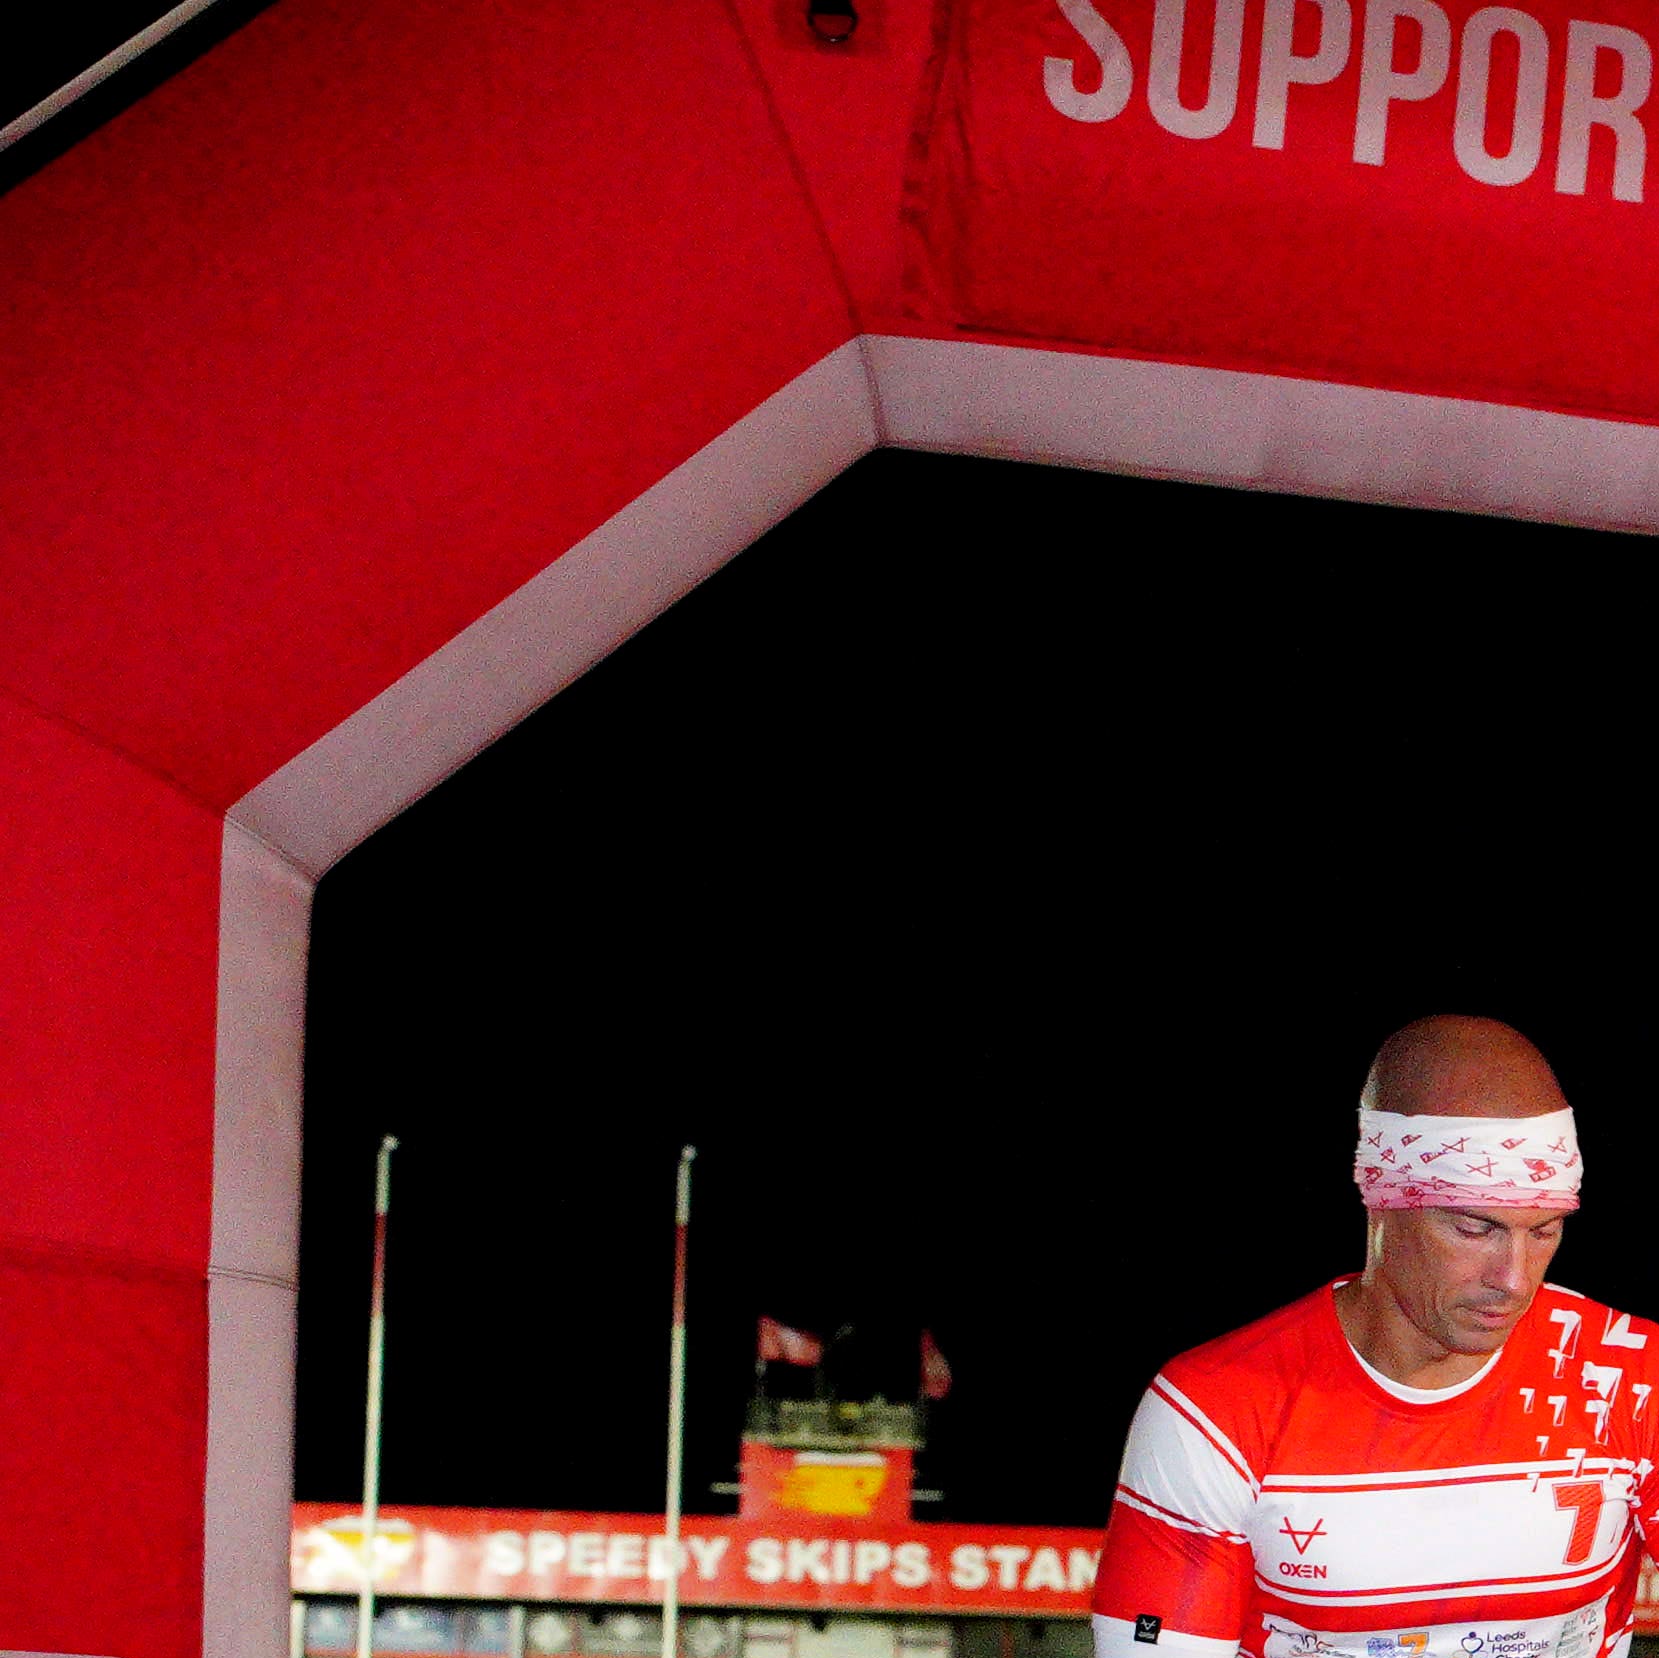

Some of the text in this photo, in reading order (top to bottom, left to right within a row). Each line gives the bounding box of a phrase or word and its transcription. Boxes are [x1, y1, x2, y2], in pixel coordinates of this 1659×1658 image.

[1552, 1480, 1604, 1565] 7
[487, 1530, 730, 1581] SPEEDY
[746, 1536, 932, 1588] SKIPS
[1279, 1562, 1327, 1578] OXEN
[1486, 1630, 1526, 1643] Leeds
[1492, 1639, 1550, 1654] Hospitals
